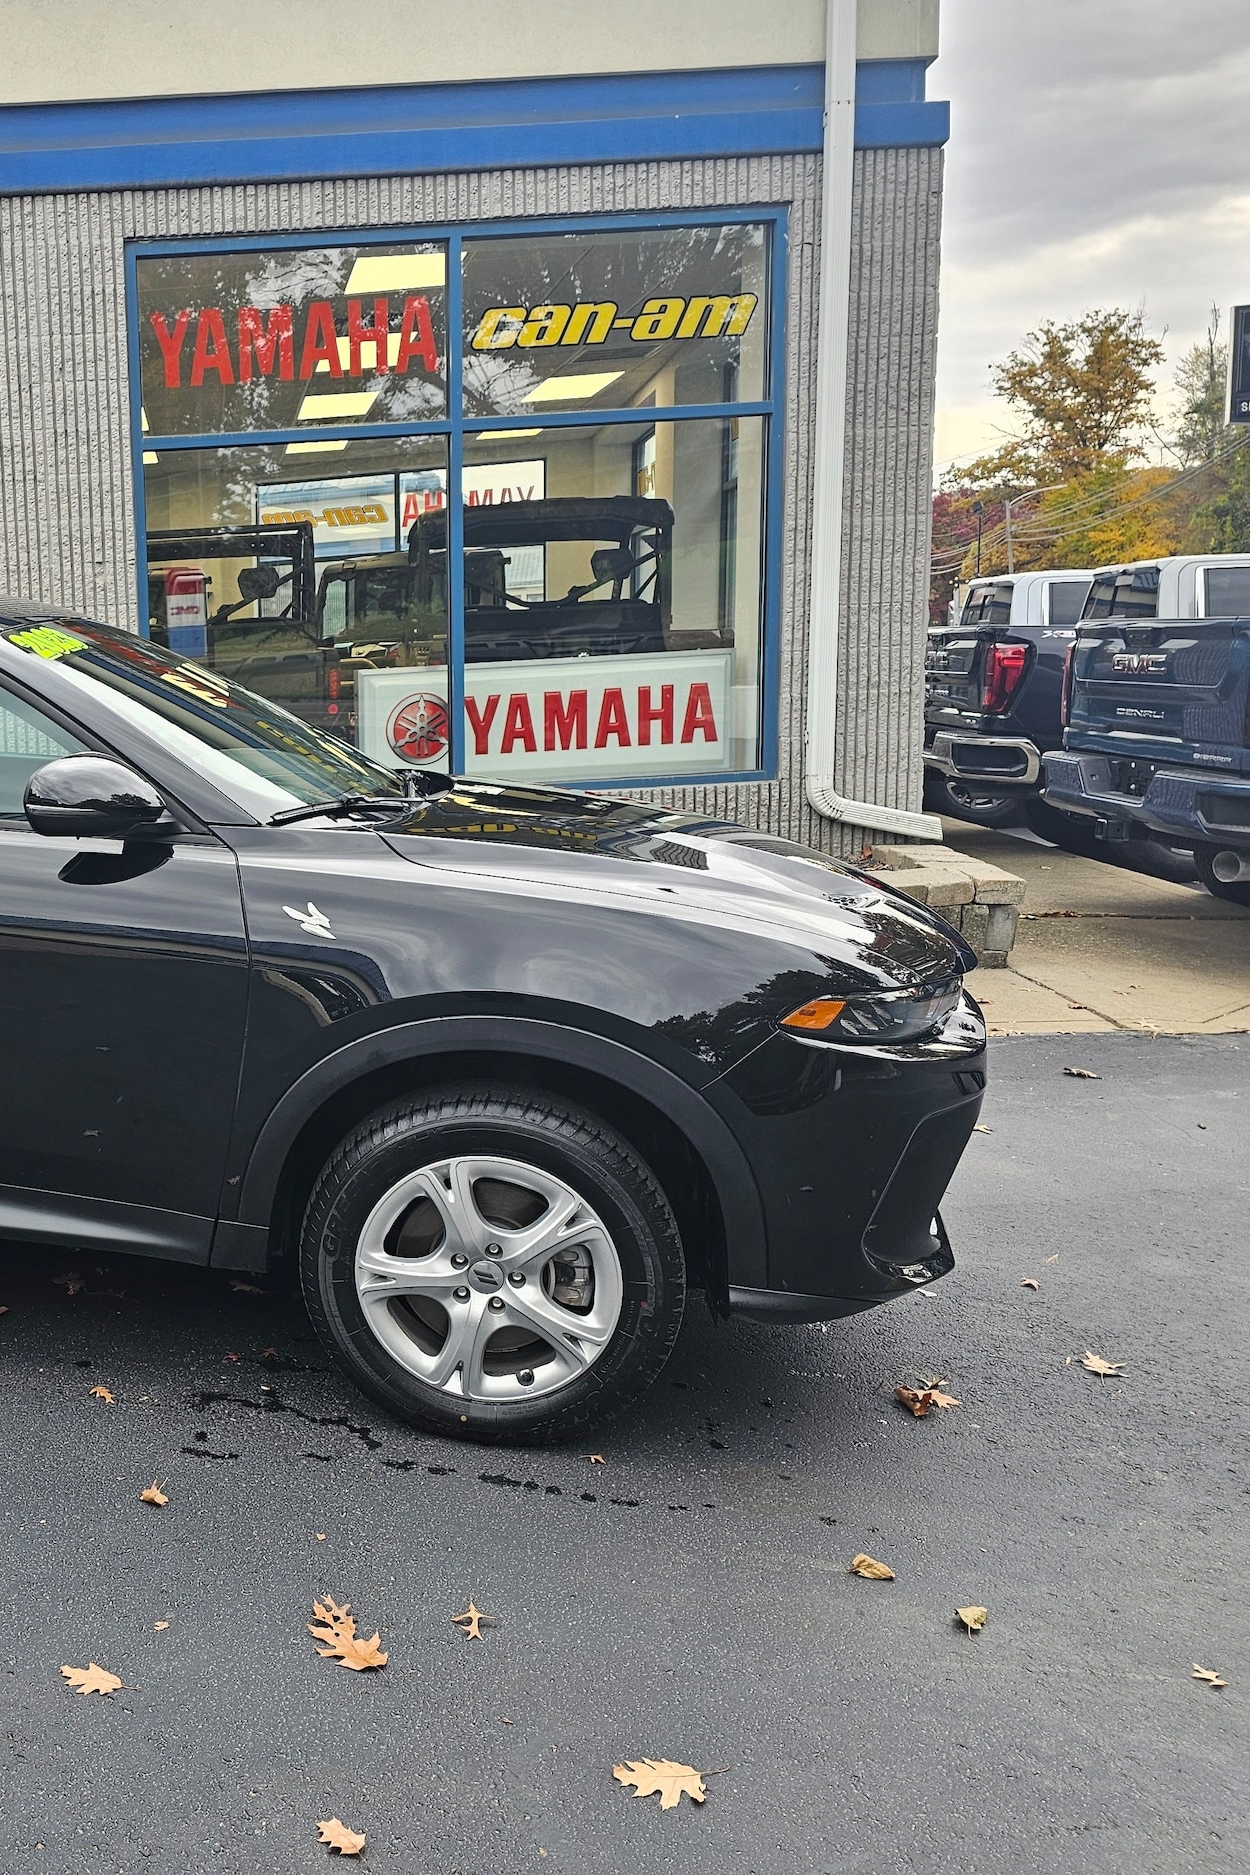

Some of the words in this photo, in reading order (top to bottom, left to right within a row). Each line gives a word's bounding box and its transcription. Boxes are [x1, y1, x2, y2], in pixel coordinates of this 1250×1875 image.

[150, 295, 440, 389] YAMAHA
[1112, 653, 1167, 674] GMC
[464, 682, 718, 756] YAMAHA
